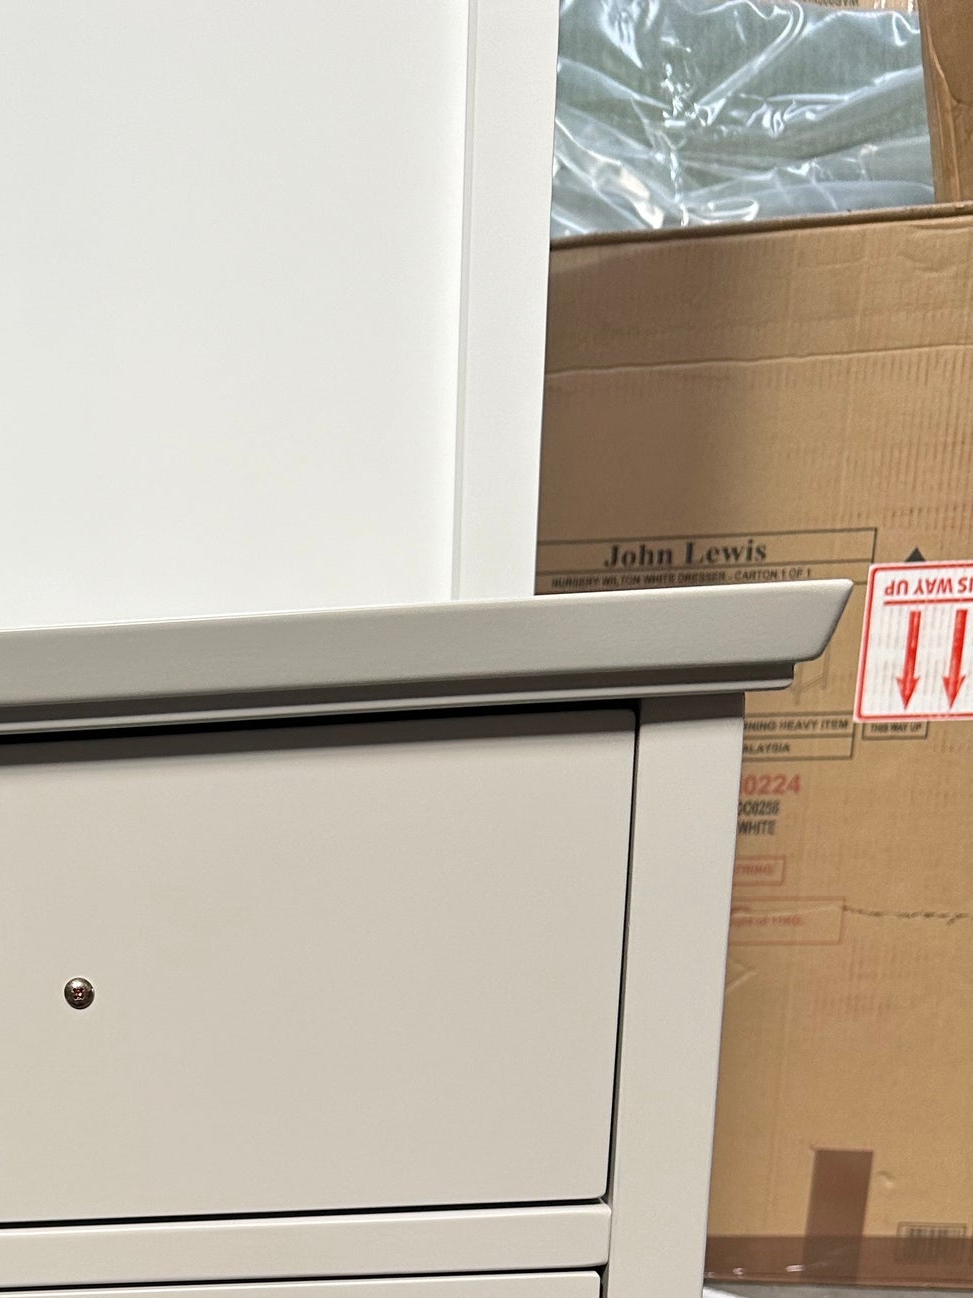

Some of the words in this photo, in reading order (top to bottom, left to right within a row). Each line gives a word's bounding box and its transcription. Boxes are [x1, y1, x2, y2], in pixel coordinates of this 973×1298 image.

[603, 544, 673, 568] John
[685, 539, 767, 564] Lewis
[734, 569, 778, 581] CARTON
[788, 567, 803, 578] OF
[884, 580, 909, 596] UP
[914, 578, 953, 595] WAY
[779, 719, 818, 731] HEAVY
[820, 718, 849, 730] ITEM
[890, 722, 908, 733] WAY
[909, 722, 922, 733] UP
